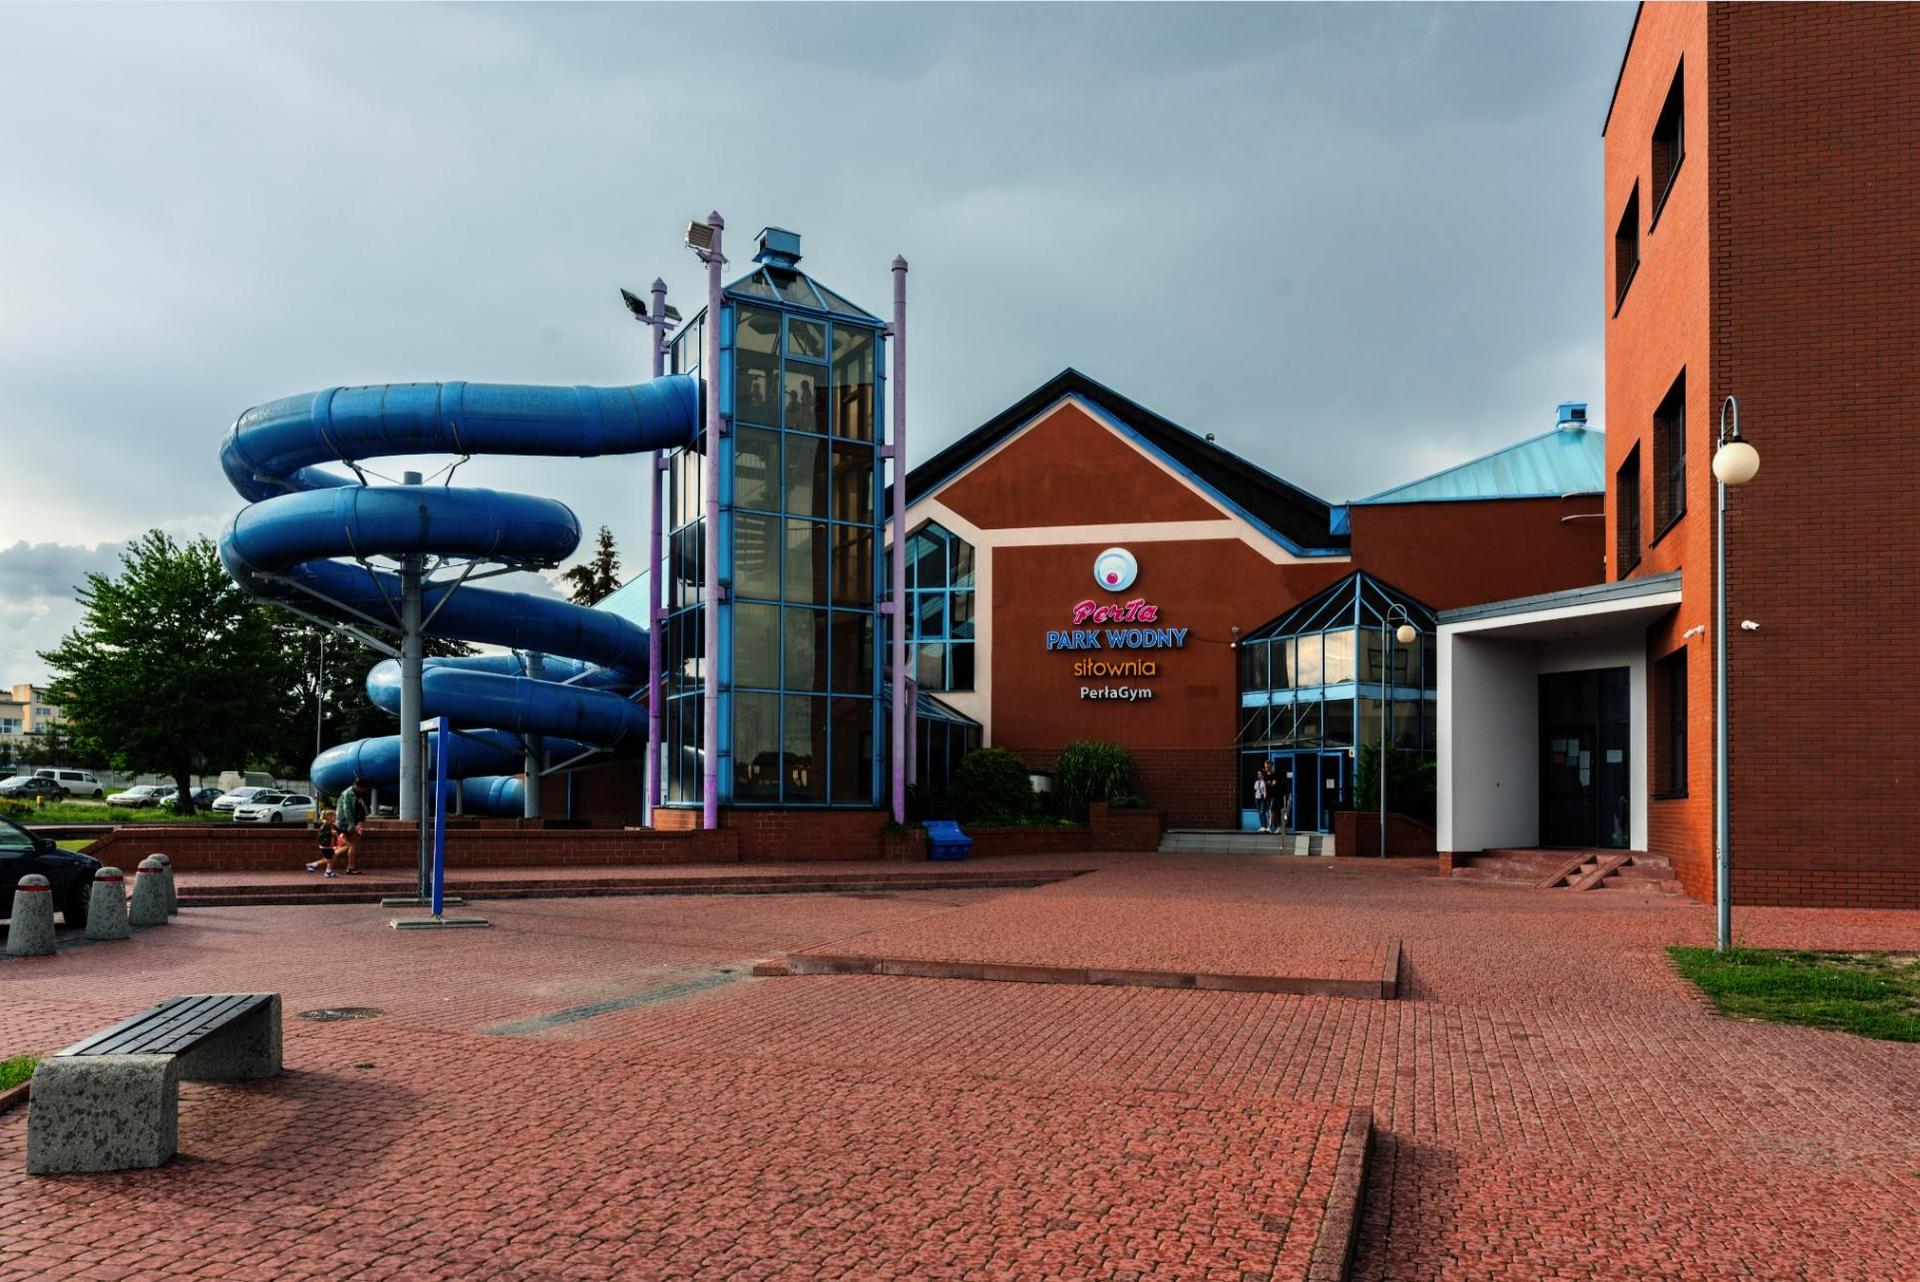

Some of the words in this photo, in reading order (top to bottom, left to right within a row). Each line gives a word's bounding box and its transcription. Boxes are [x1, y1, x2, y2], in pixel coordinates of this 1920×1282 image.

[1047, 631, 1101, 649] PARK
[1106, 628, 1188, 648] WODNY
[1074, 658, 1155, 676] siłownia
[1080, 687, 1152, 701] PerłaGym
